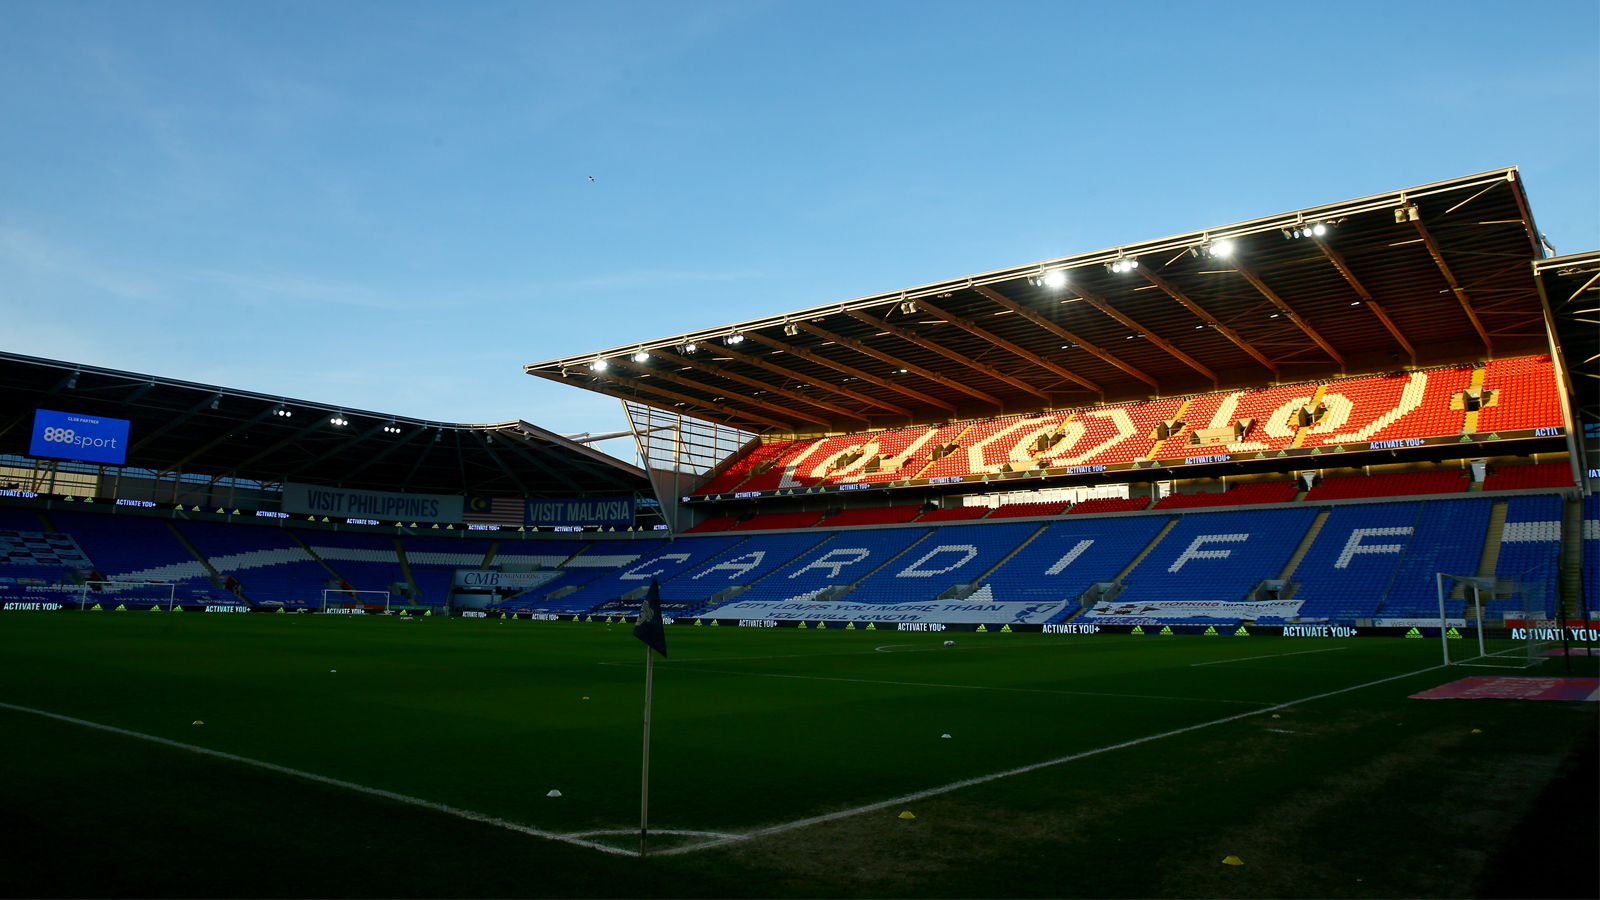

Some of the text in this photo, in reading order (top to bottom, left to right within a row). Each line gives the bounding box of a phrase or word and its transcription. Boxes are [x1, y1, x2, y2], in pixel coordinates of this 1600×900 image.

[44, 427, 116, 448] 888sport
[1370, 438, 1425, 449] ACTIVATE YOU+
[1185, 455, 1209, 465] ACTIVATE
[1066, 466, 1091, 474] ACTIVATE
[116, 499, 142, 507] ACTIVATE
[308, 489, 438, 518] VISIT PHILIPPINES
[530, 501, 630, 521] VISIT MALAYSIA
[464, 572, 500, 585] CMB
[3, 603, 63, 611] ACTIVATE YOU+
[205, 605, 234, 613] ACTIVATE
[874, 604, 939, 612] MORE
[739, 619, 762, 627] ACTIVATE
[897, 623, 946, 631] ACTIVATE YOU+
[1042, 624, 1100, 634] ACTIVATE YOU+
[1283, 627, 1358, 637] ACTIVATE YOU+
